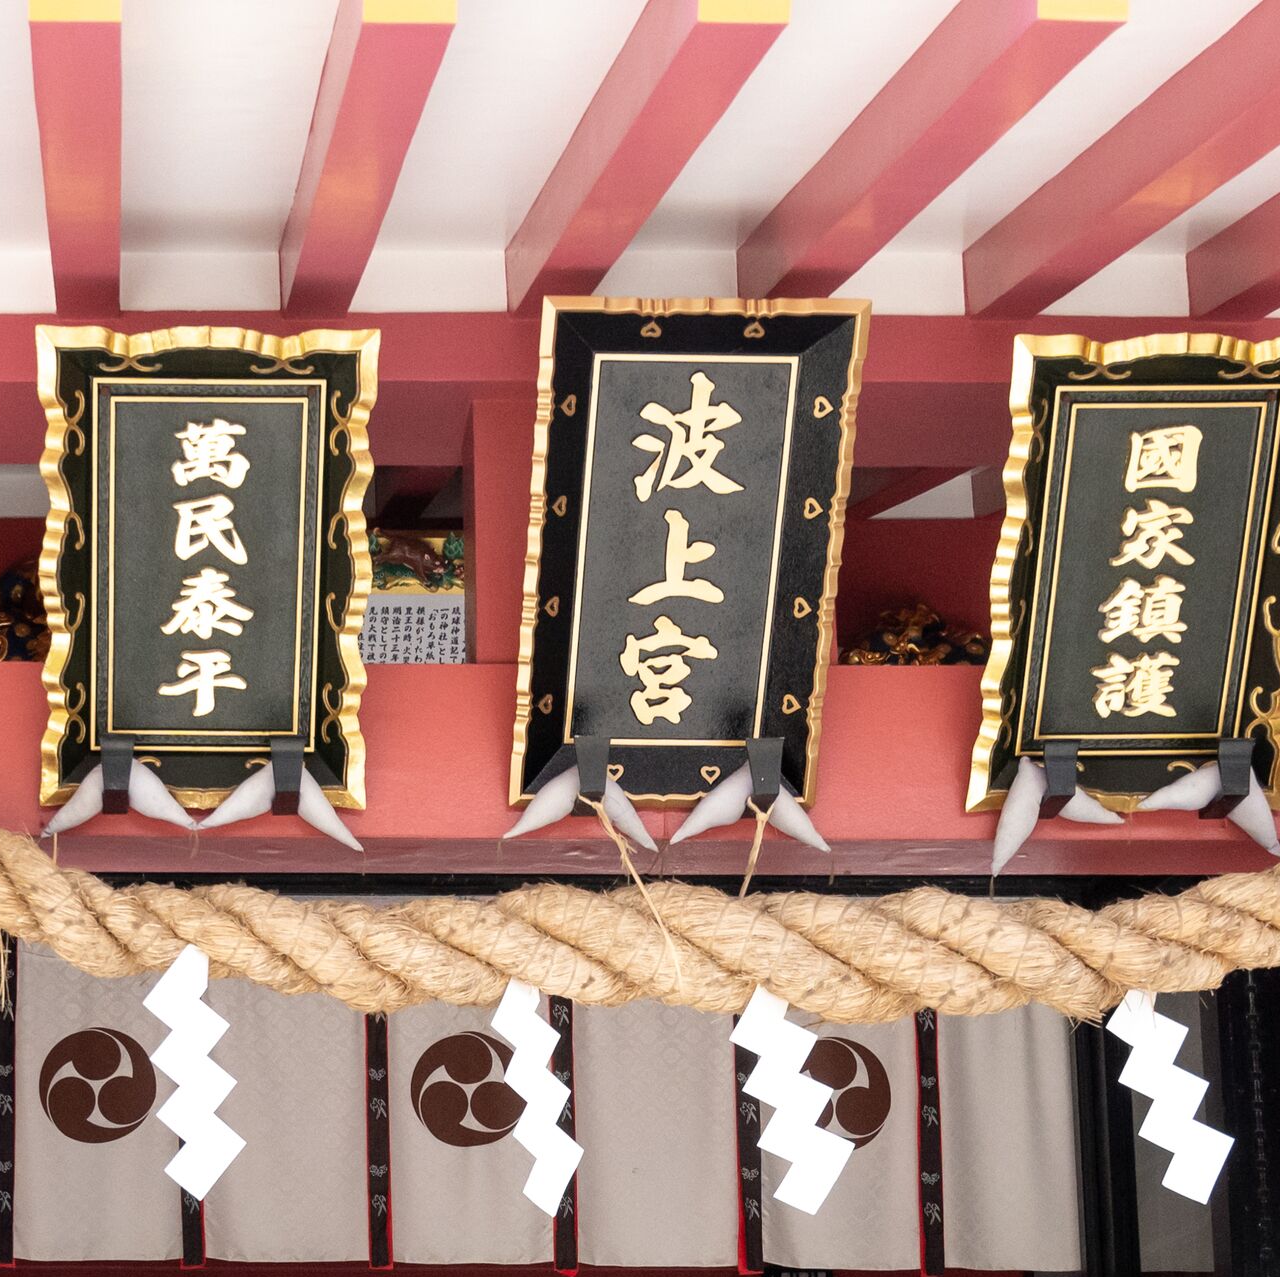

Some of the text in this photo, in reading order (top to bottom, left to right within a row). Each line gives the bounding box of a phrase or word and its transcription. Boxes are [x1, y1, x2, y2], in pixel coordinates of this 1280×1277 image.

[156, 417, 254, 719] 萬民泰平
[379, 606, 390, 664] 鎮守としての
[619, 372, 746, 727] 波上宮
[1090, 422, 1206, 720] 國家鎮護
